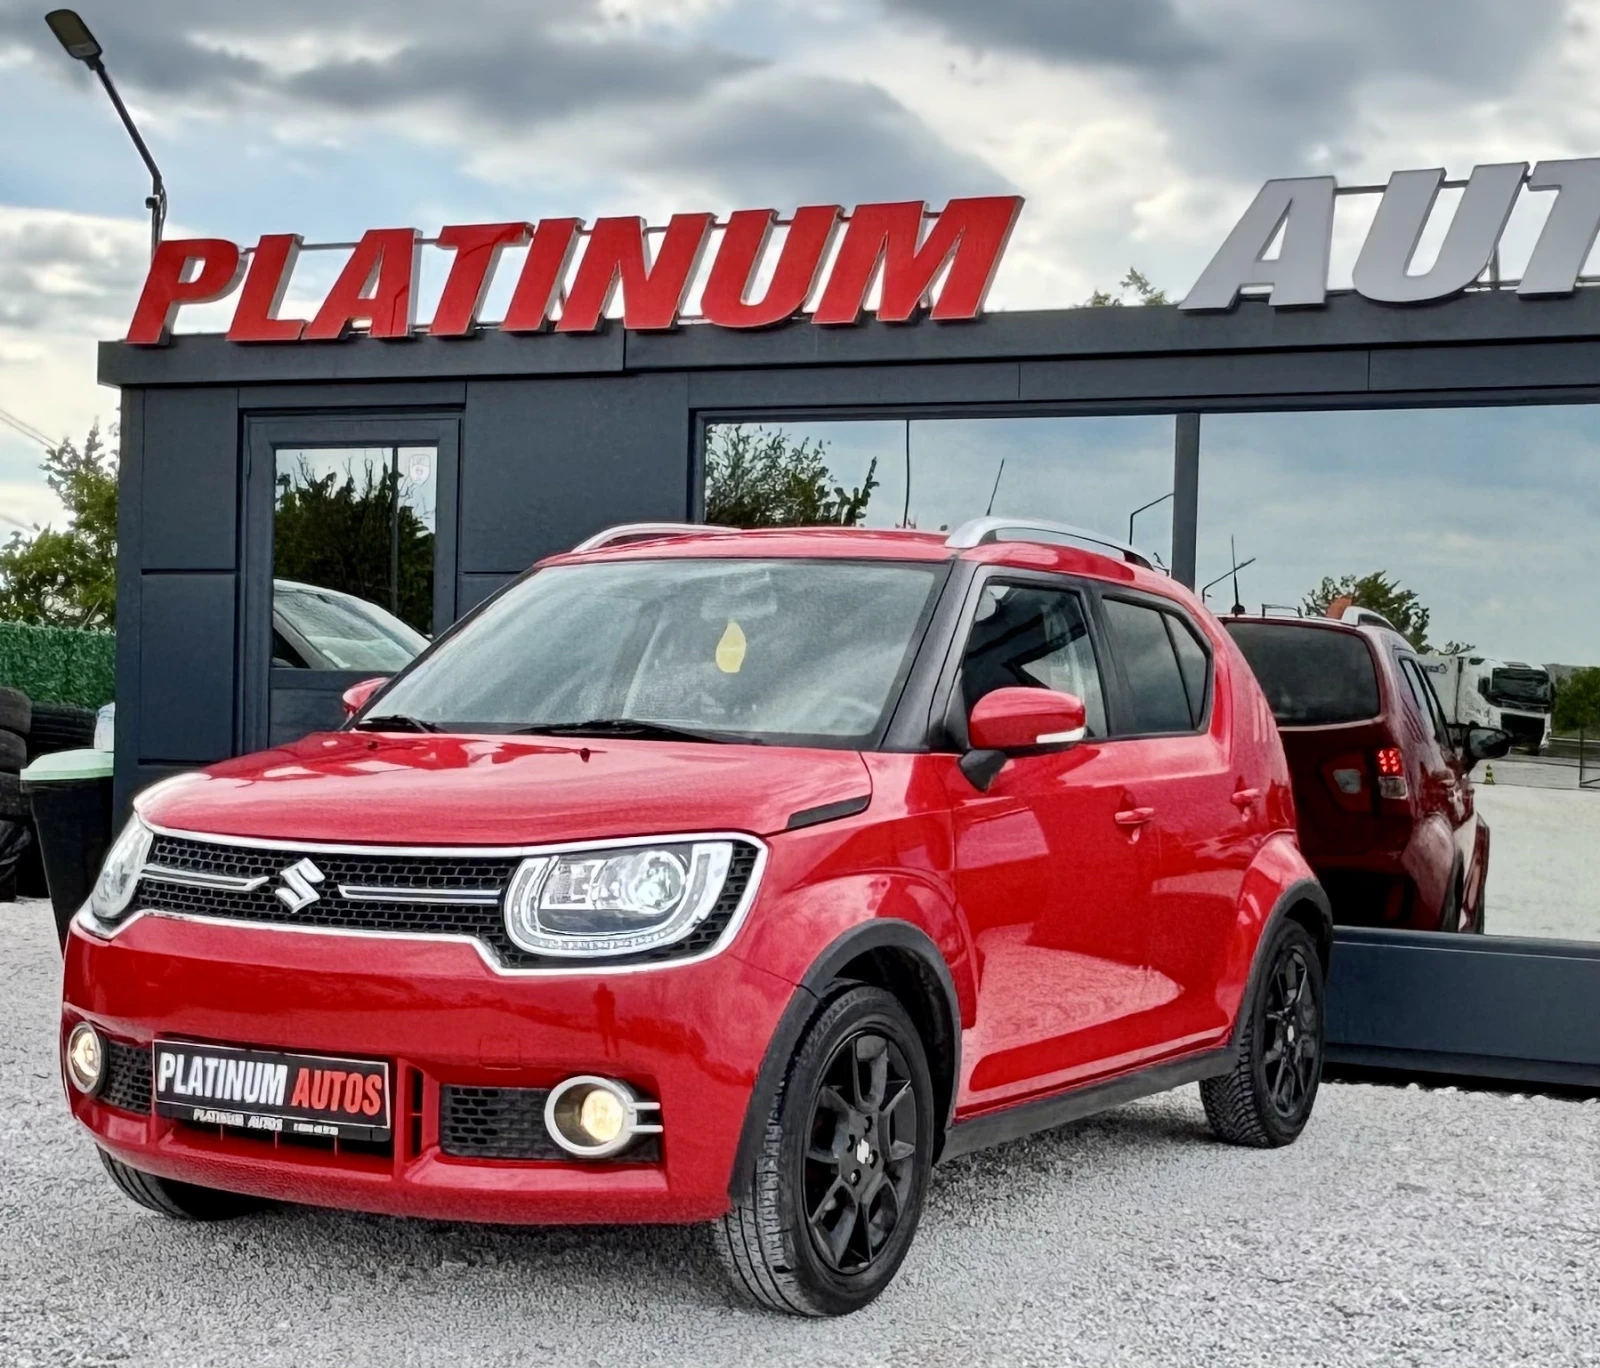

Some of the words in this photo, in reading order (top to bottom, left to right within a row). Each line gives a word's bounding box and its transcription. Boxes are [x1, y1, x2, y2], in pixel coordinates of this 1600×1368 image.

[126, 194, 1025, 345] PLATINUM
[158, 1052, 288, 1106] PLATINUM
[291, 1067, 382, 1116] AUTOS
